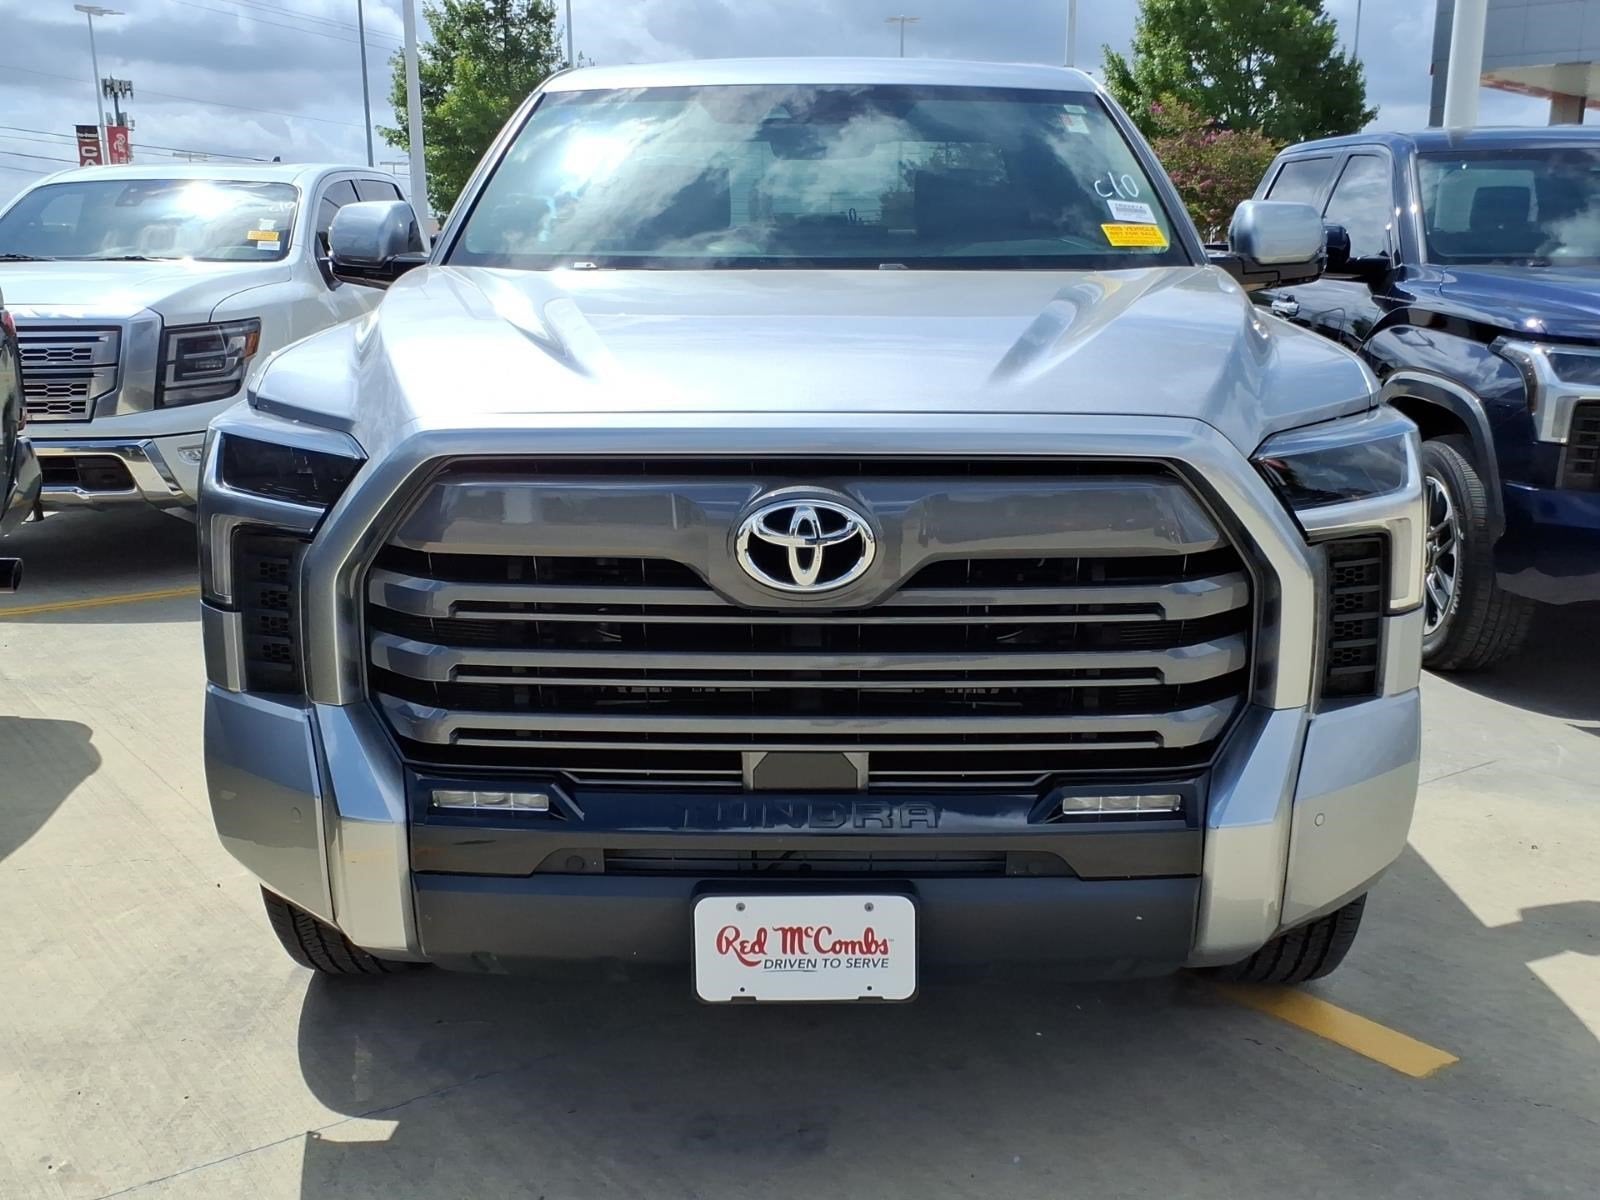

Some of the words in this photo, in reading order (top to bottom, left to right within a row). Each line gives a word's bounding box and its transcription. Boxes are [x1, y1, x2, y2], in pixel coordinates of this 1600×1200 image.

[716, 925, 768, 967] Red
[772, 926, 889, 955] McCombs
[763, 958, 817, 969] DRIVEN
[822, 958, 840, 968] TO
[845, 958, 889, 968] SERVE
